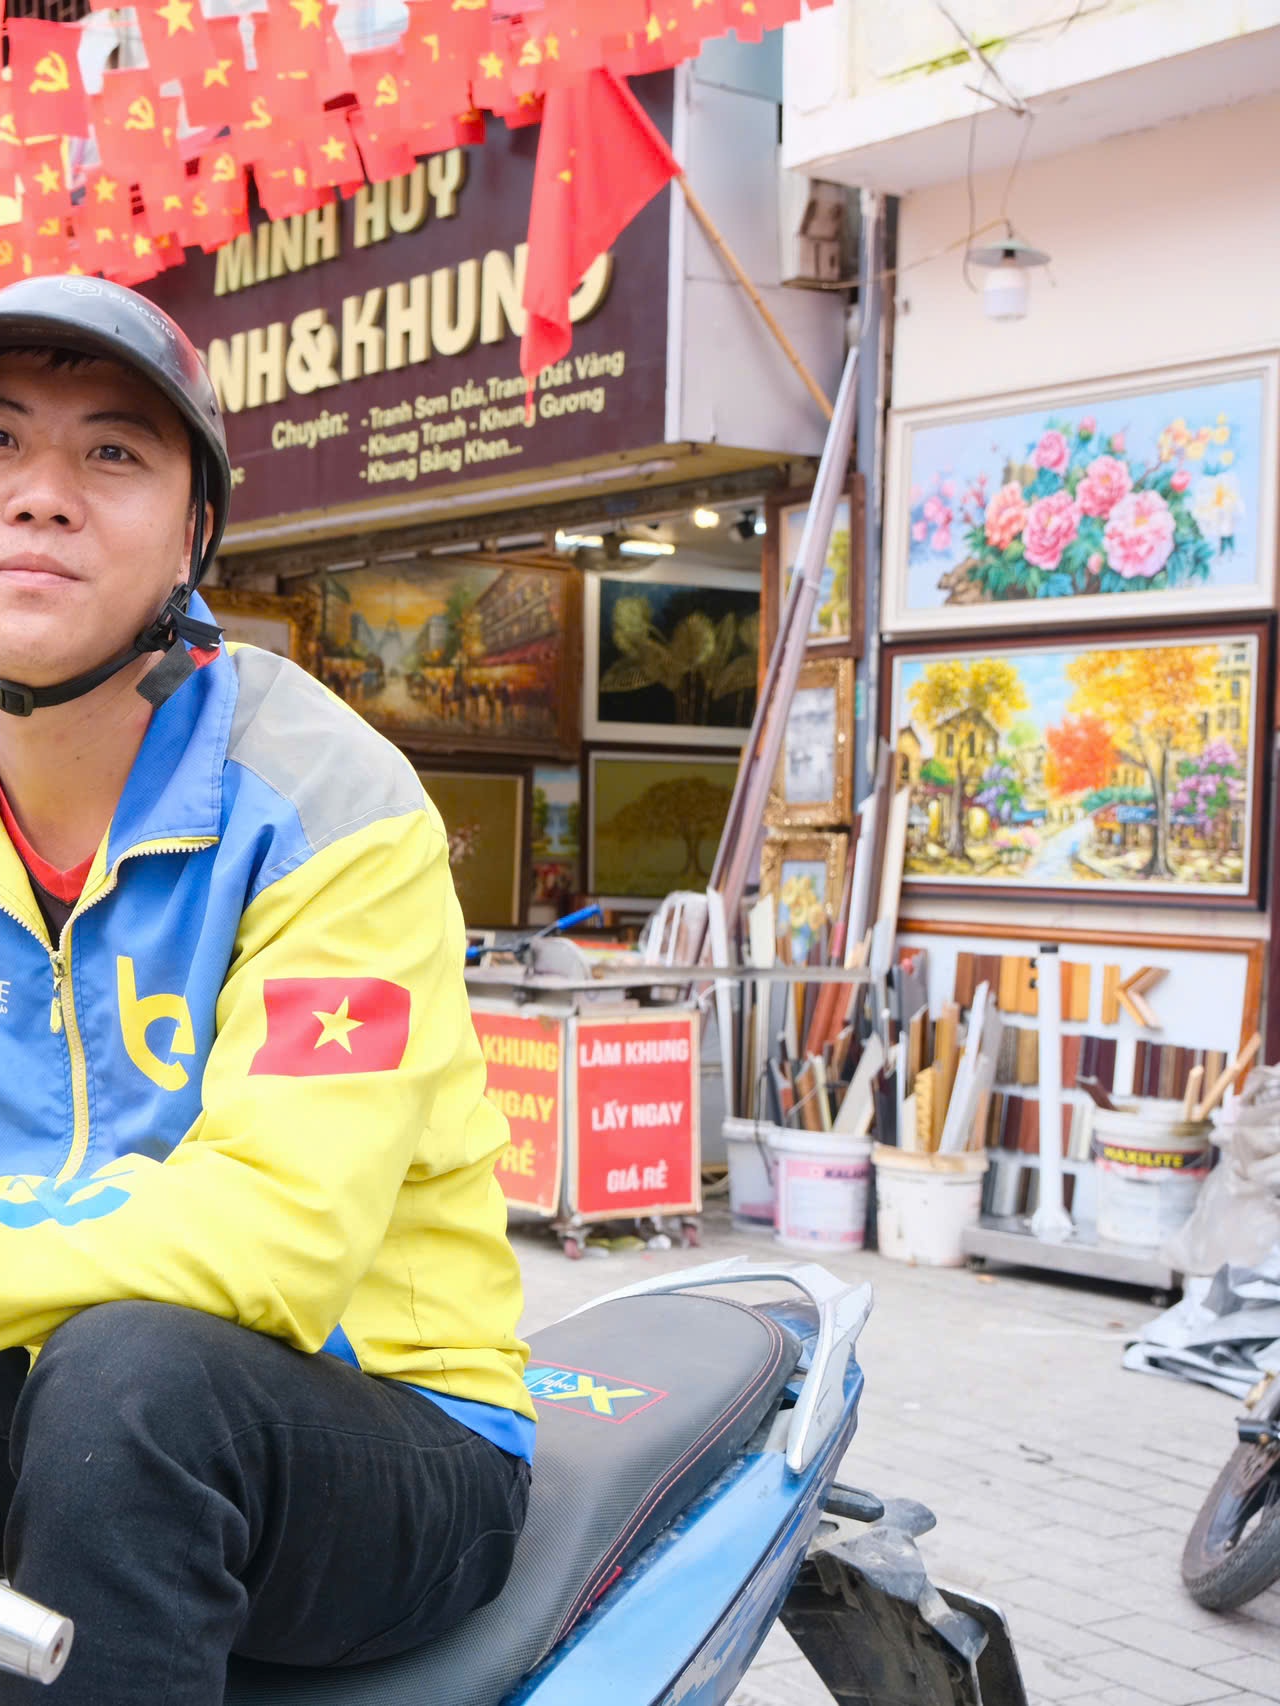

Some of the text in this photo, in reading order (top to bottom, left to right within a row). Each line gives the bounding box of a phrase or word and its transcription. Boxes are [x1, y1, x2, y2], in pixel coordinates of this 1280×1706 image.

[214, 148, 464, 297] MINH HUY
[421, 415, 466, 446] Tranh
[481, 1035, 559, 1072] KHUNG
[580, 1039, 689, 1068] LÀM KHUNG
[486, 1087, 554, 1124] NGAY
[632, 1101, 683, 1129] NGAY
[607, 1165, 640, 1194] GIÁ
